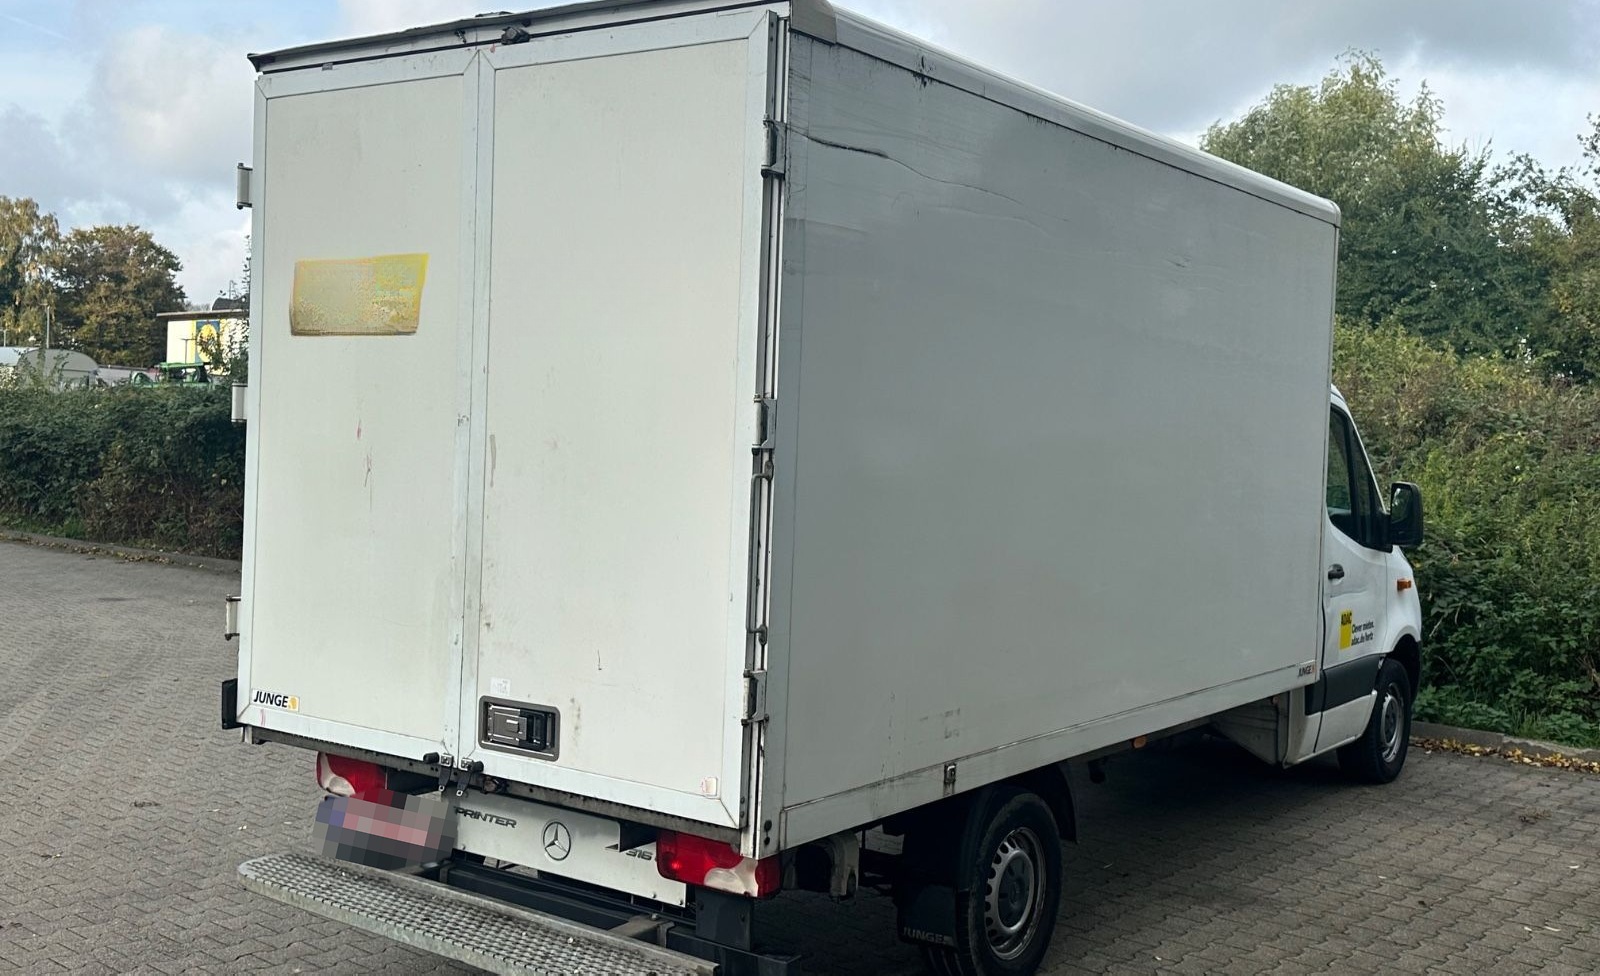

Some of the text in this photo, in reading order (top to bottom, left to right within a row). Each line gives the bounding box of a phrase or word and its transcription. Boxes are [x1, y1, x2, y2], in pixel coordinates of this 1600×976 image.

[1341, 611, 1352, 625] ADAC
[1297, 665, 1312, 678] JUNGE
[253, 690, 289, 708] JUNGE
[453, 806, 517, 828] PRINTER
[626, 849, 653, 861] 316
[901, 926, 945, 945] JUNGE
